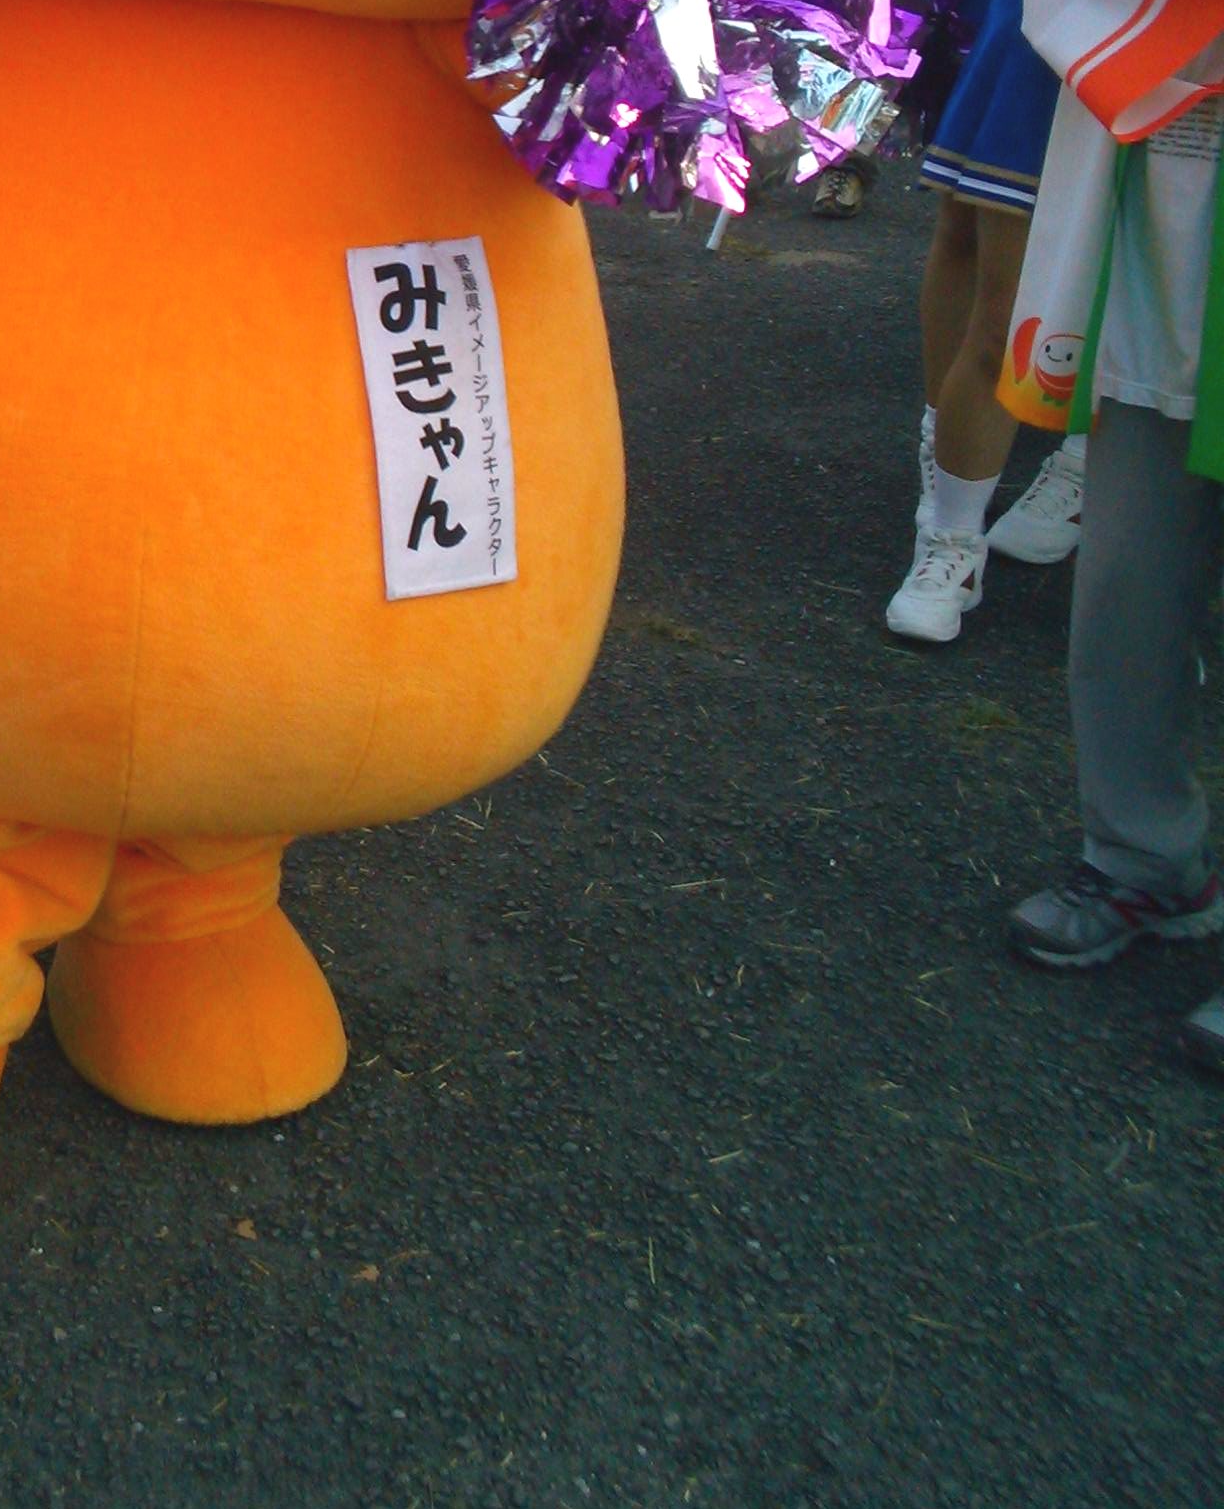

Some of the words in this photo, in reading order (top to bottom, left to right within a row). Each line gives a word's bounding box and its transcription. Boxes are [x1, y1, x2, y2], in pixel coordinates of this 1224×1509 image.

[373, 261, 467, 552] みきゃん
[453, 253, 508, 576] 愛媛県イメージアップキャラクター
